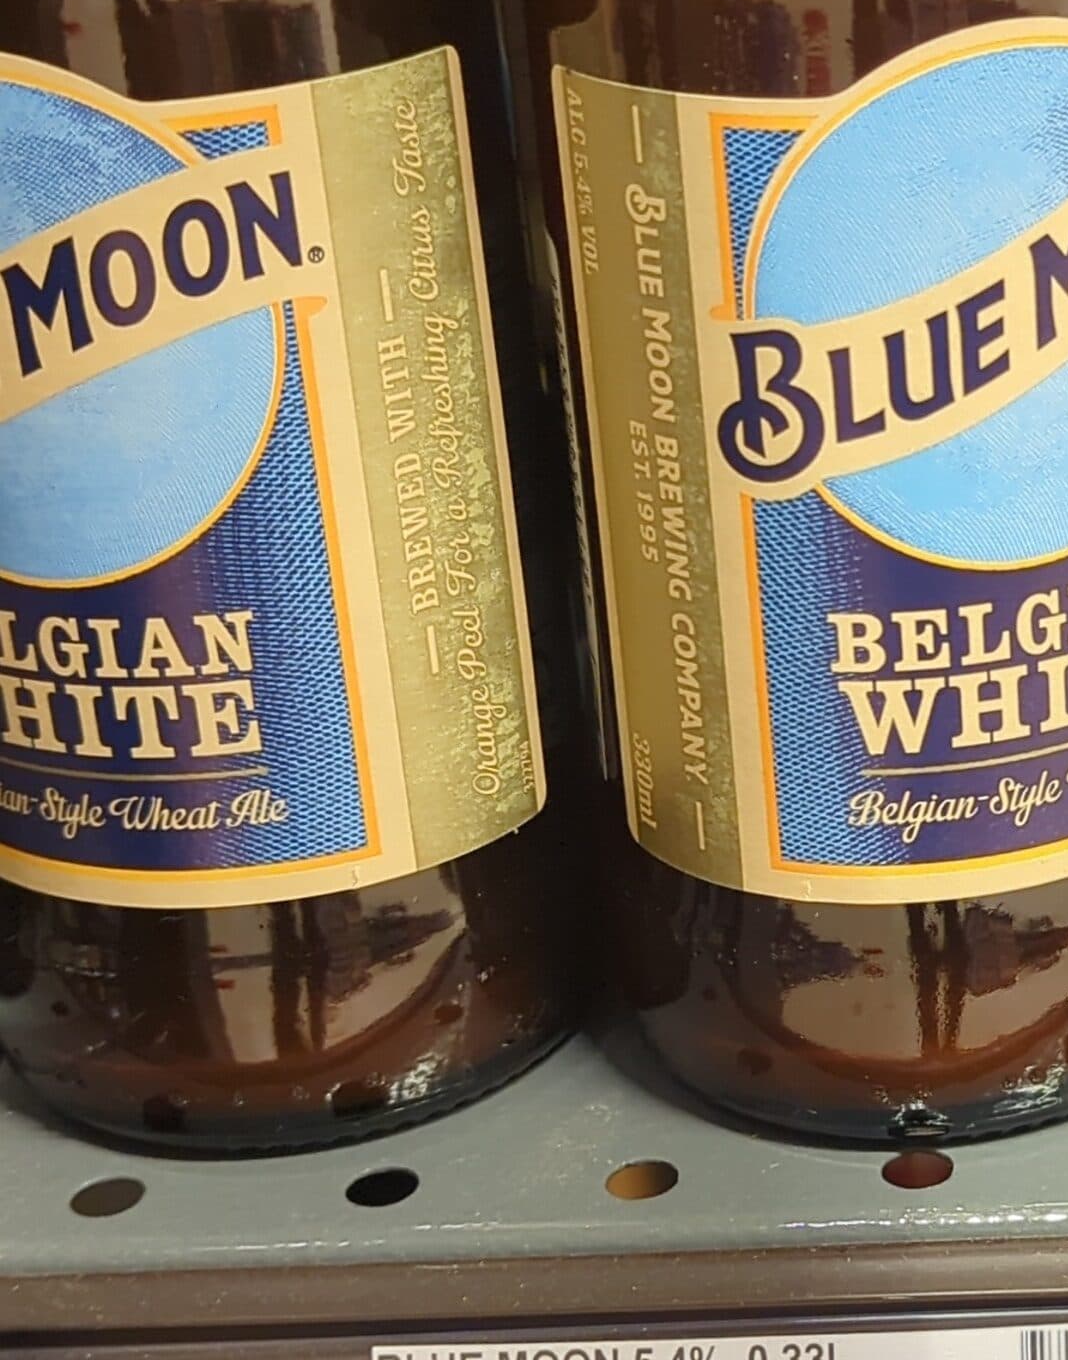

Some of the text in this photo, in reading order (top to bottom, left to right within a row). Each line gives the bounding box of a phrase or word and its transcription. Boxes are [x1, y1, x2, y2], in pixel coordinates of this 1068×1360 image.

[566, 87, 599, 276] ALC 5.4% VOL
[624, 183, 667, 298] BLUE
[641, 307, 677, 424] MOON
[717, 279, 1011, 483] BLUE
[377, 334, 440, 615] BREWED WITH
[393, 98, 506, 796] Orange Peel For a Refreshing Citrus Taste
[629, 419, 660, 564] EST. 1995
[653, 433, 692, 601] BREWING
[0, 611, 253, 678] LGIAN
[0, 674, 263, 758] HITE
[110, 796, 220, 830] Wheat
[226, 790, 288, 827] Ale
[632, 732, 657, 829] 330ml
[848, 771, 1062, 843] Belgian-Style
